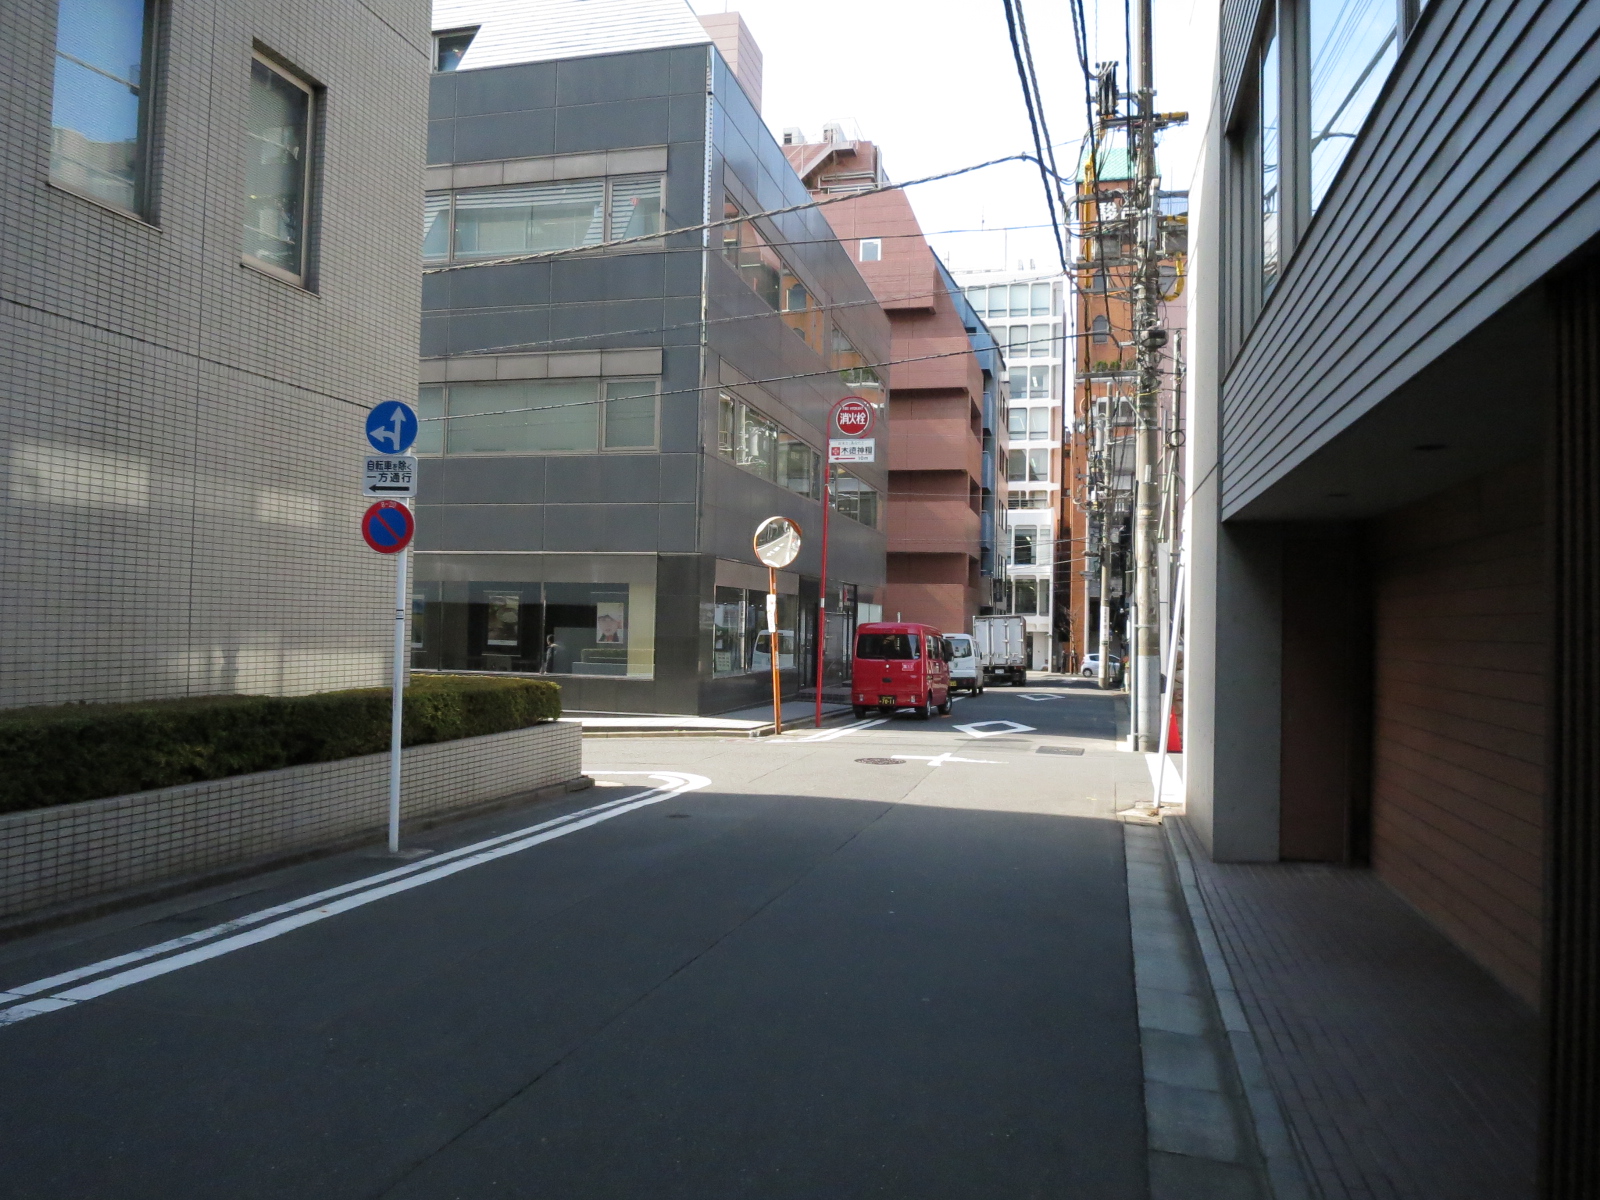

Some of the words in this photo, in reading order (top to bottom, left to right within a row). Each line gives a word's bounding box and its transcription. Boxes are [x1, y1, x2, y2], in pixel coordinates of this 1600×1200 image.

[840, 412, 866, 424] 消火栓
[367, 460, 412, 471] 自転車を除く
[367, 472, 412, 483] 一方通行
